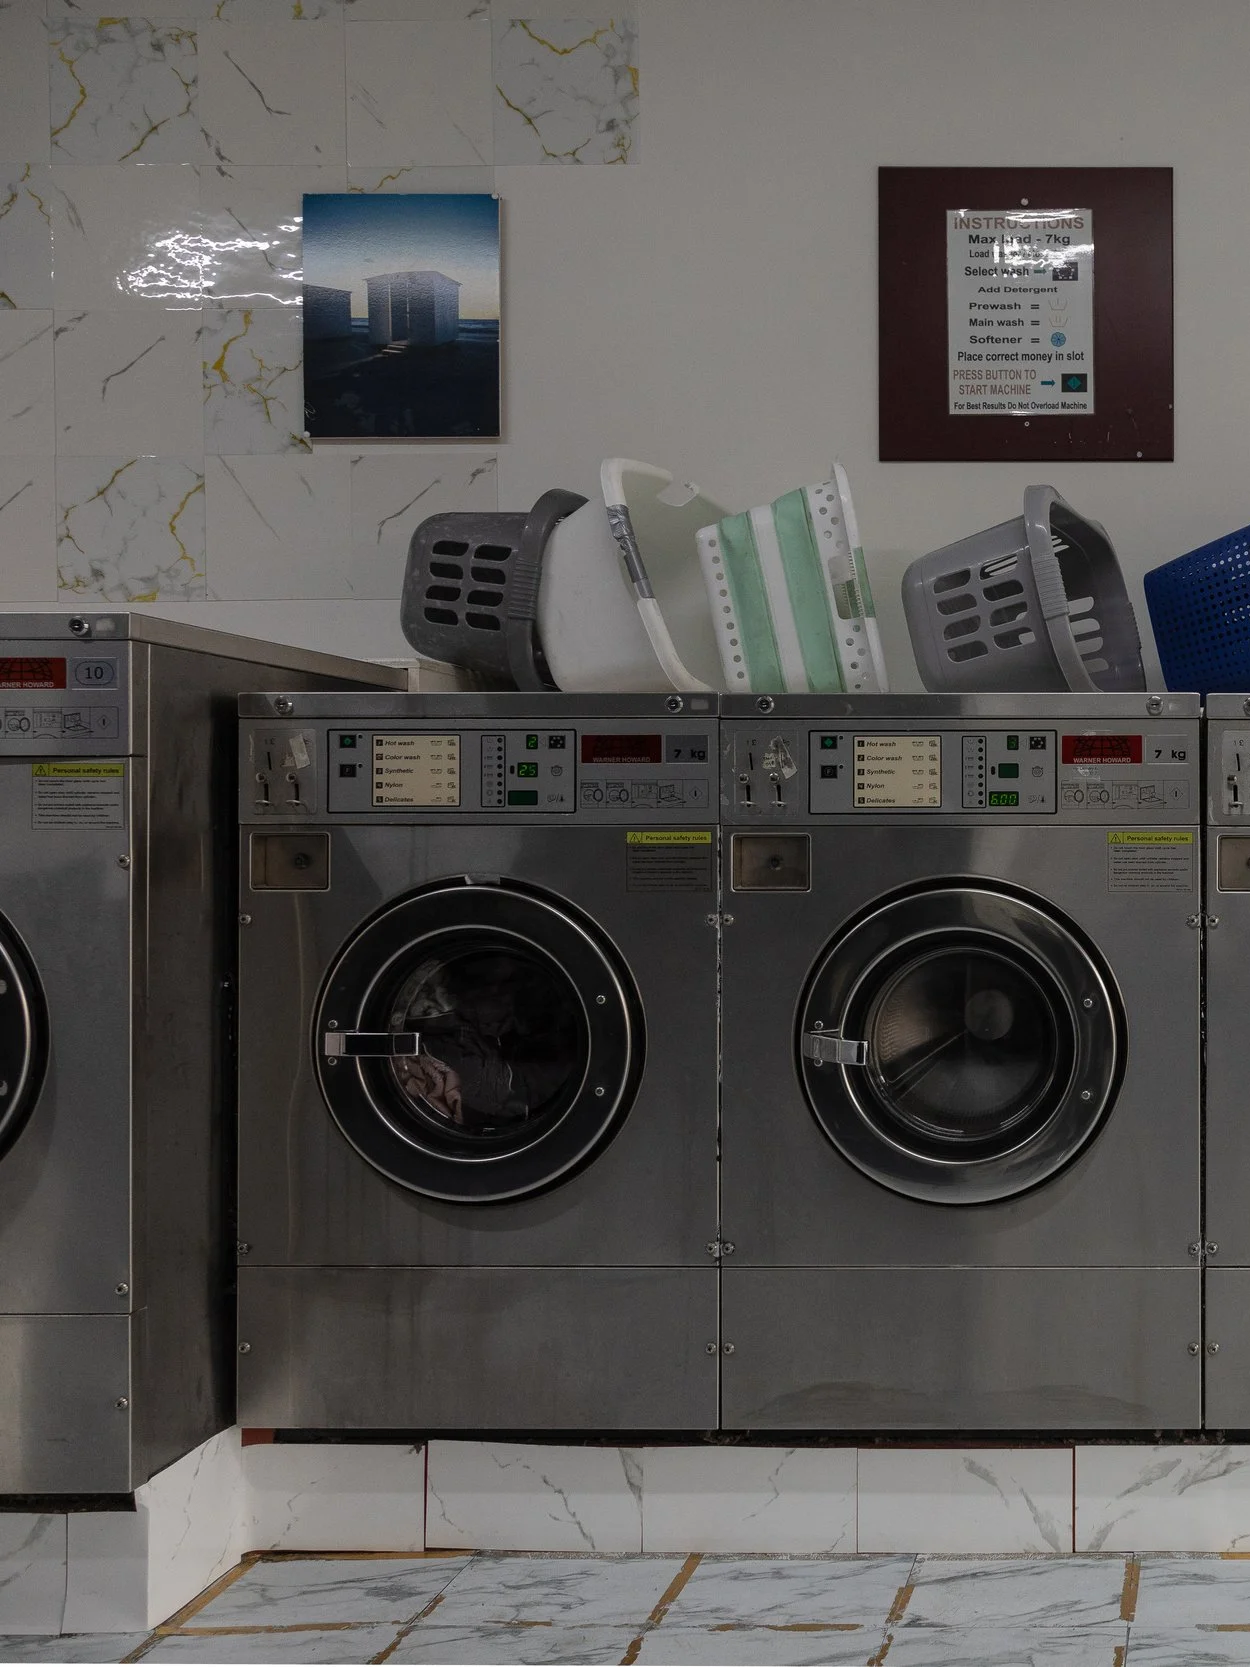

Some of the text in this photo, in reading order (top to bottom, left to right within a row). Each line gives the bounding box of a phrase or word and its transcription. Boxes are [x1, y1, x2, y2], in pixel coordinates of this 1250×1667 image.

[968, 235, 997, 245] Max
[1045, 235, 1071, 246] 7kg
[969, 250, 990, 258] Load
[964, 266, 1030, 277] Select wash
[977, 286, 1059, 296] Add Detergent
[968, 302, 1022, 310] Prewash
[969, 318, 995, 327] Main
[997, 318, 1025, 327] wash
[969, 335, 1023, 344] Softener
[957, 351, 1085, 363] Place correct money in slot
[953, 369, 1037, 380] PRESS BUTTON TO
[959, 384, 1032, 395] START MACHINE
[954, 402, 1088, 410] For Best Results Do Not Overload Machine
[85, 666, 105, 680] 10
[23, 681, 55, 689] HOWARD
[673, 749, 707, 761] 7 kg
[1154, 749, 1187, 761] 7 kg
